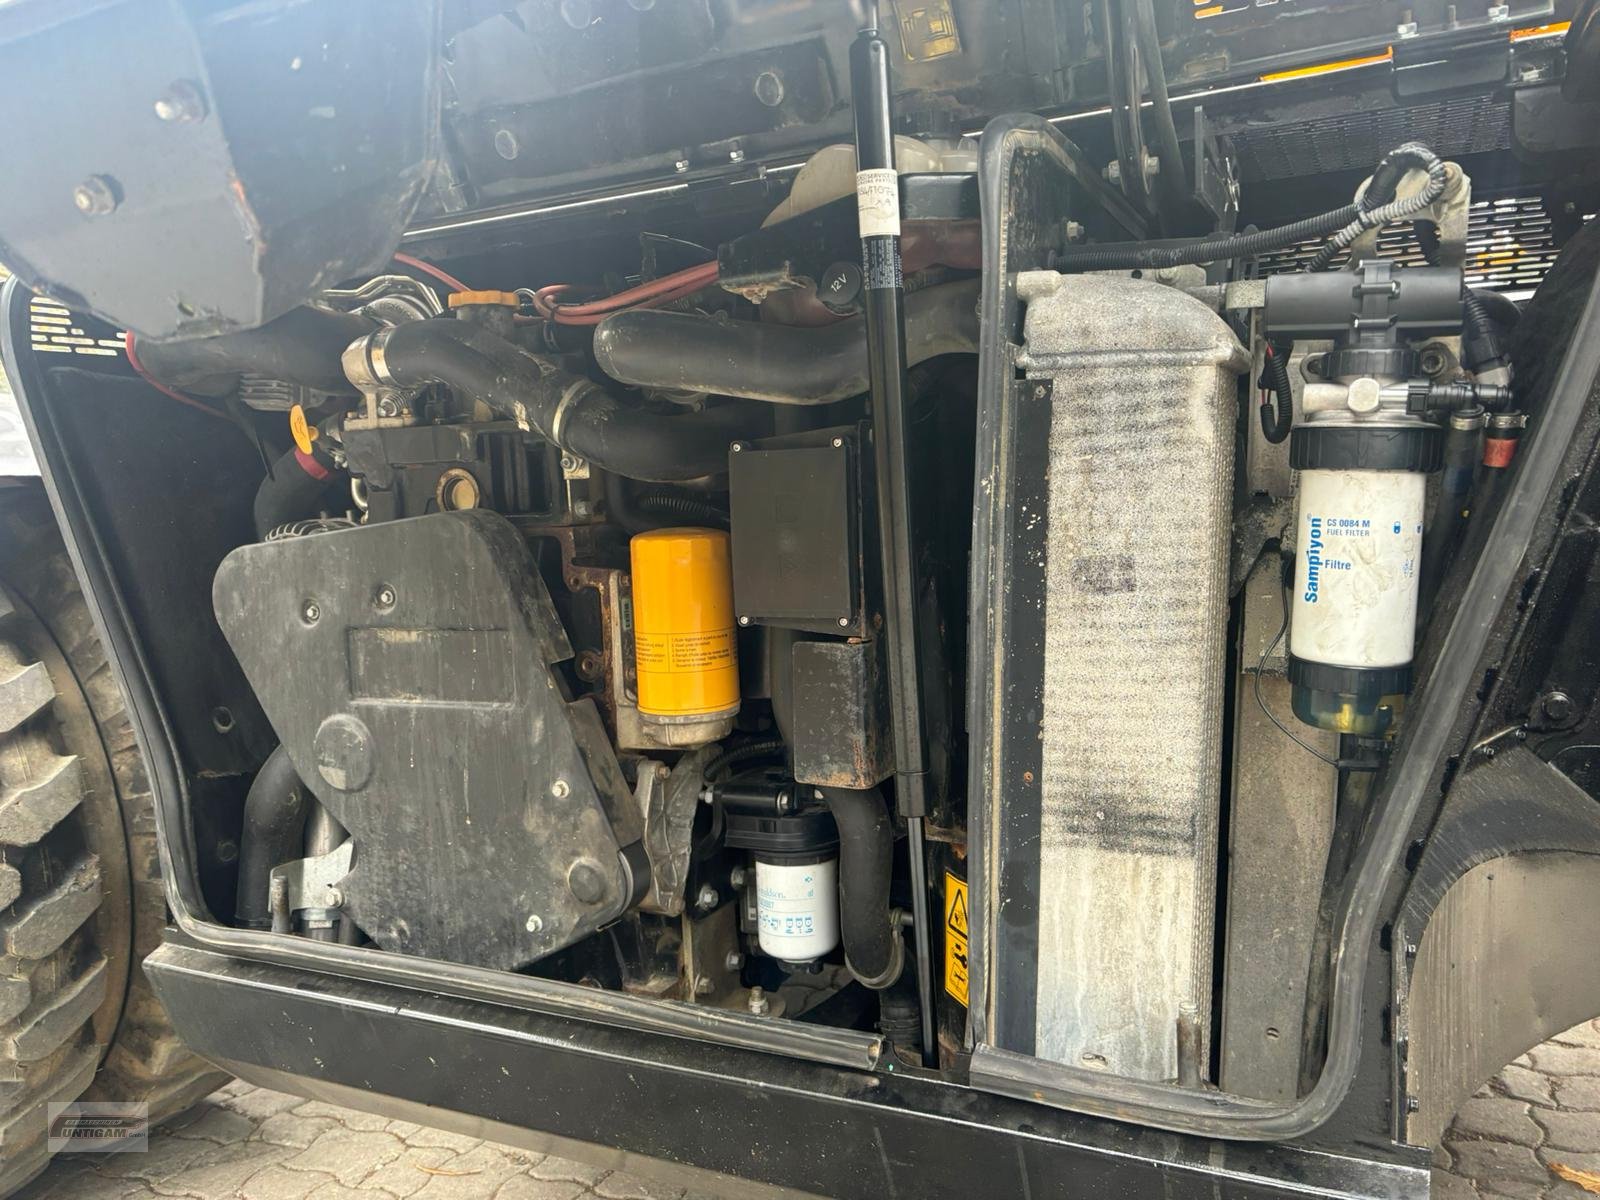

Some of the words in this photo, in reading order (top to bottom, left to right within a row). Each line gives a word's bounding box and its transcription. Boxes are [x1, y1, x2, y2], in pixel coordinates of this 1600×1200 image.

[1327, 519, 1337, 527] CS
[1339, 519, 1360, 527] 0084
[1345, 529, 1370, 537] FILTER
[1304, 517, 1324, 603] Sampiyon
[1325, 559, 1352, 571] Filtre
